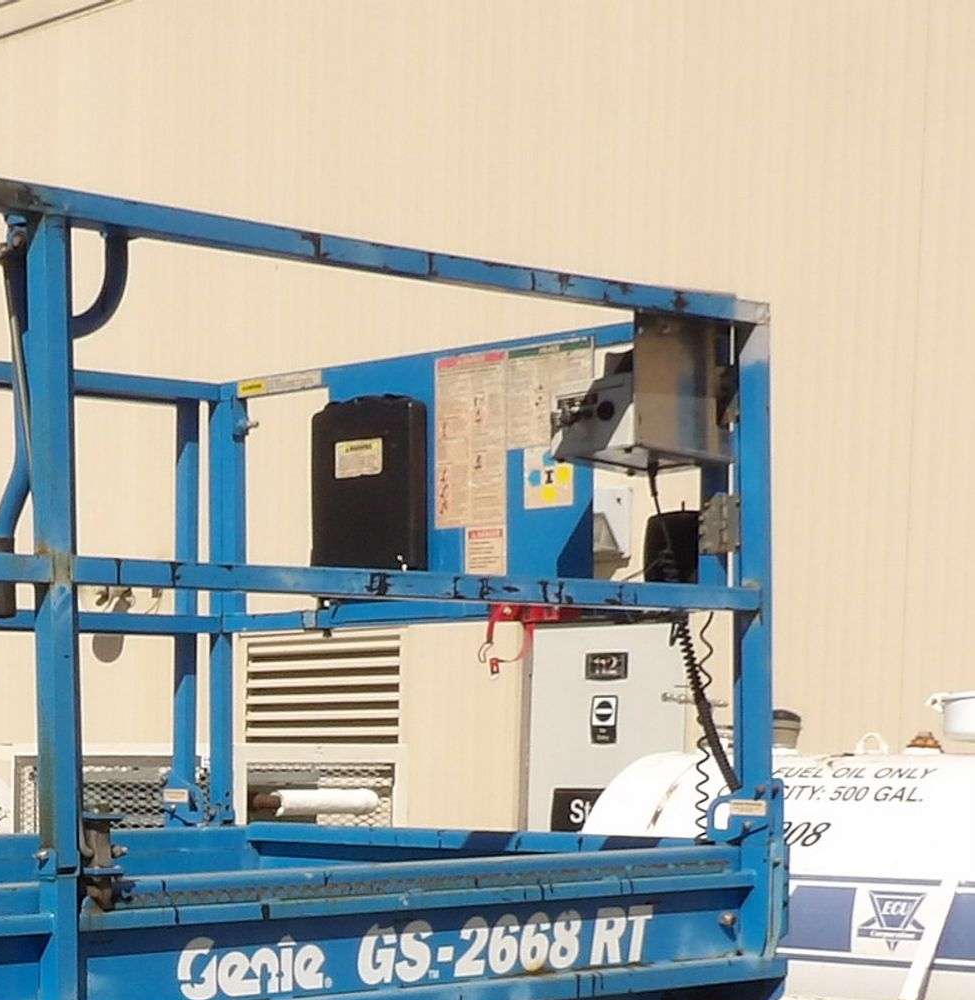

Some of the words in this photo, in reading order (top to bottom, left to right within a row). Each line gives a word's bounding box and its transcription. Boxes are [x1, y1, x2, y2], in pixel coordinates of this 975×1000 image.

[831, 767, 866, 779] OIL
[873, 767, 938, 780] ONLY
[829, 785, 870, 802] 500
[873, 785, 924, 802] GAL.
[177, 936, 327, 1000] Genie
[357, 909, 582, 985] GS-2668
[589, 904, 654, 966] RT
